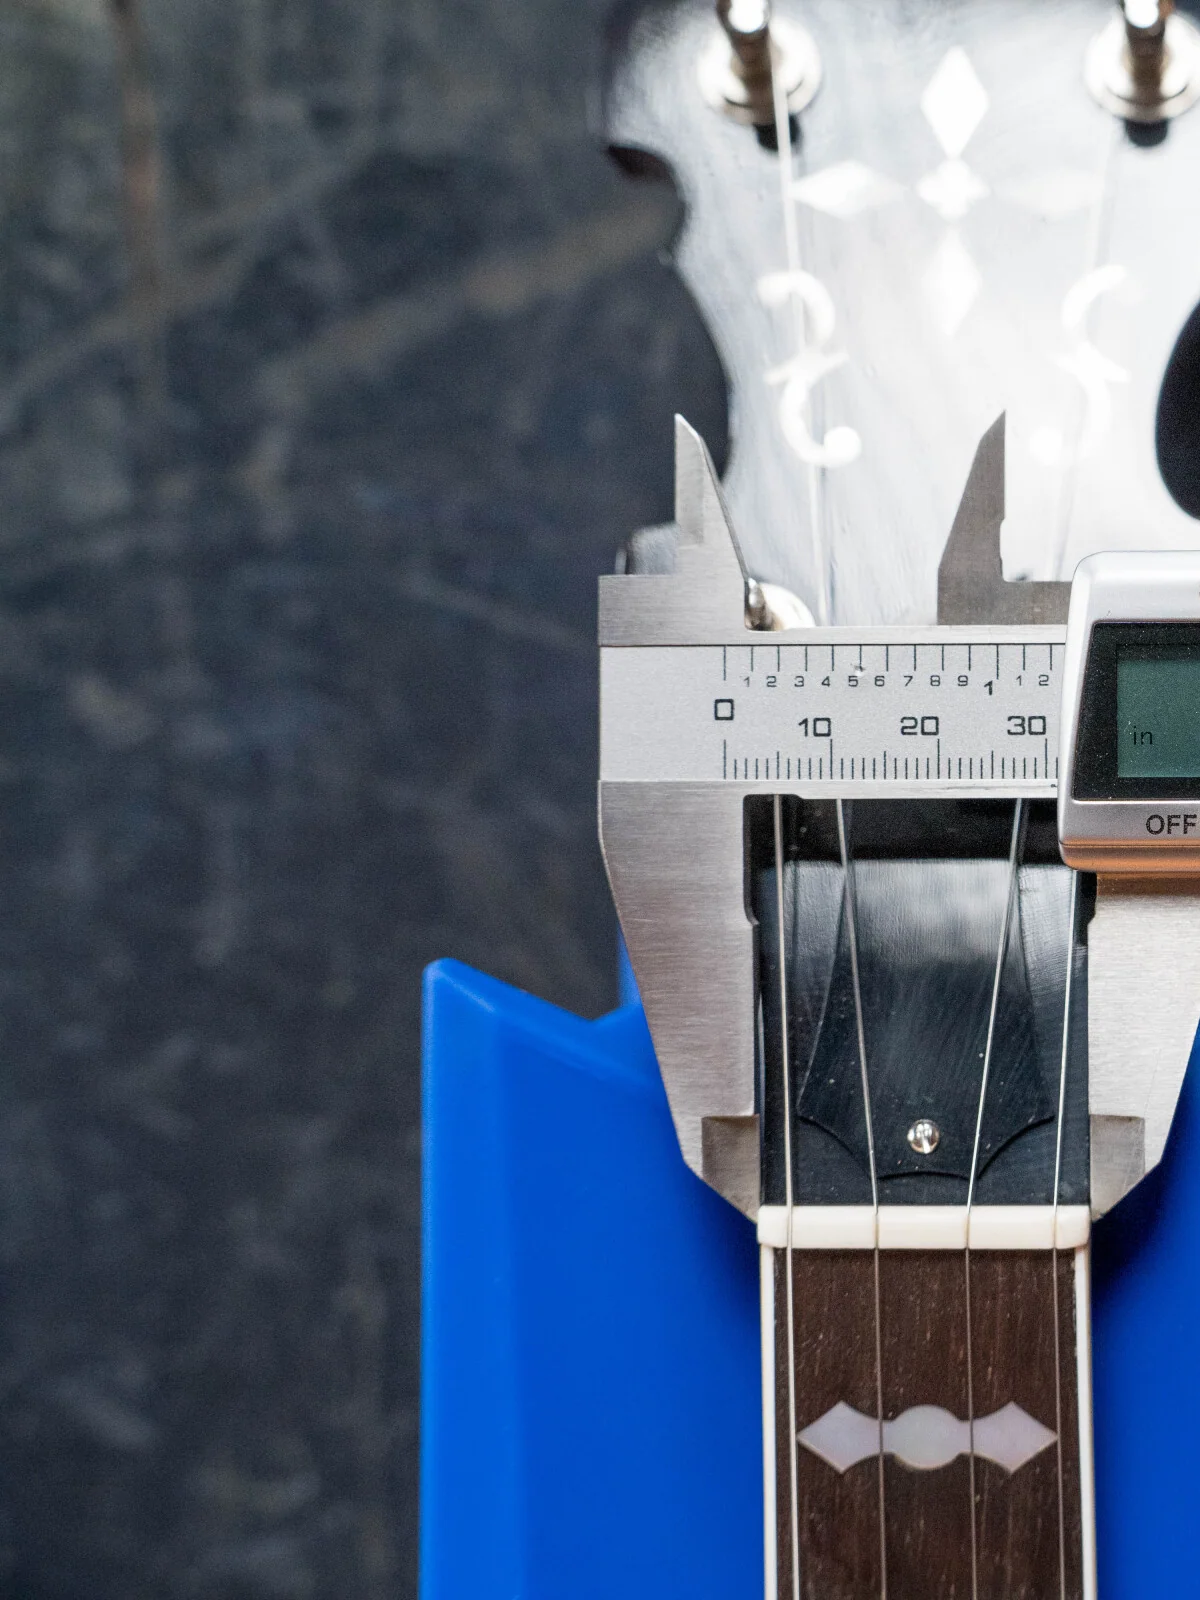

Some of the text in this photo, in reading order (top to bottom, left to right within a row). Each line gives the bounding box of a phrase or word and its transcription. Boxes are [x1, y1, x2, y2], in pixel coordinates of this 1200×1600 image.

[742, 674, 1050, 696] 1 2 3 4 5 6 7 8 9 1 1 2
[713, 698, 1047, 738] 0 10 20 30
[1131, 725, 1155, 747] in
[1145, 813, 1198, 837] OFF
